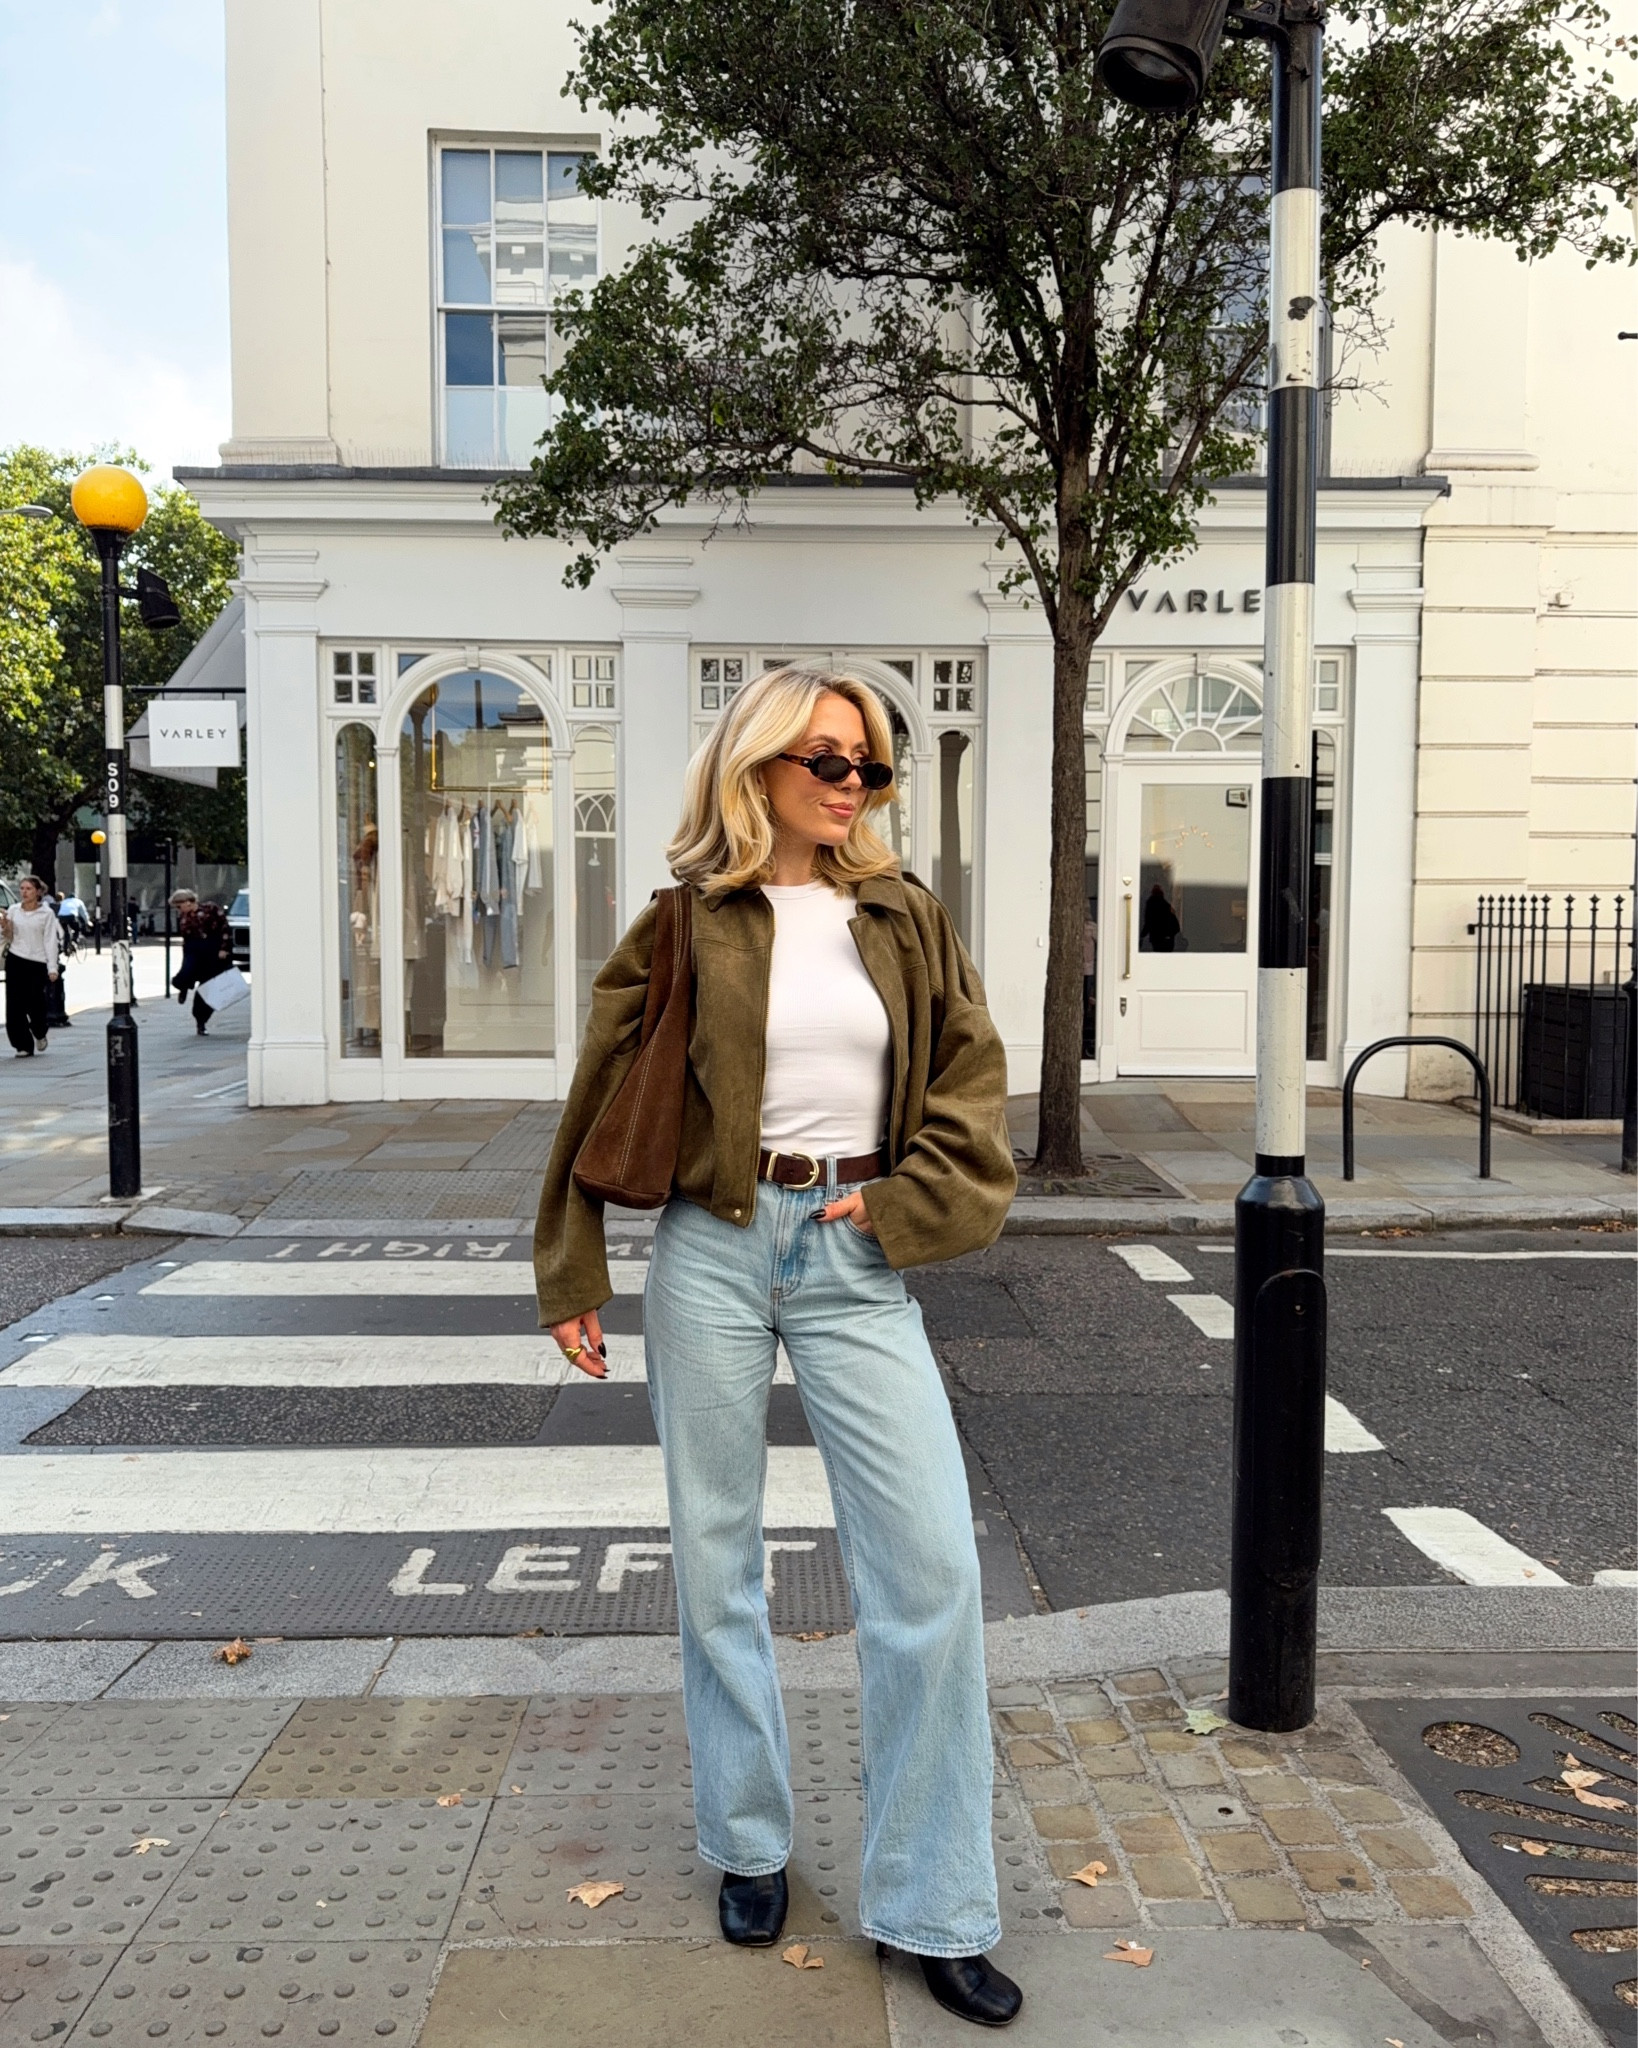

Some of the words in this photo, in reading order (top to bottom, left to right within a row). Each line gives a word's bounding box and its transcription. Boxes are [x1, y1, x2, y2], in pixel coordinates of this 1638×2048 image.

[1127, 589, 1261, 613] VARLE
[160, 729, 227, 739] VARLEY
[266, 1241, 512, 1259] RIGHT
